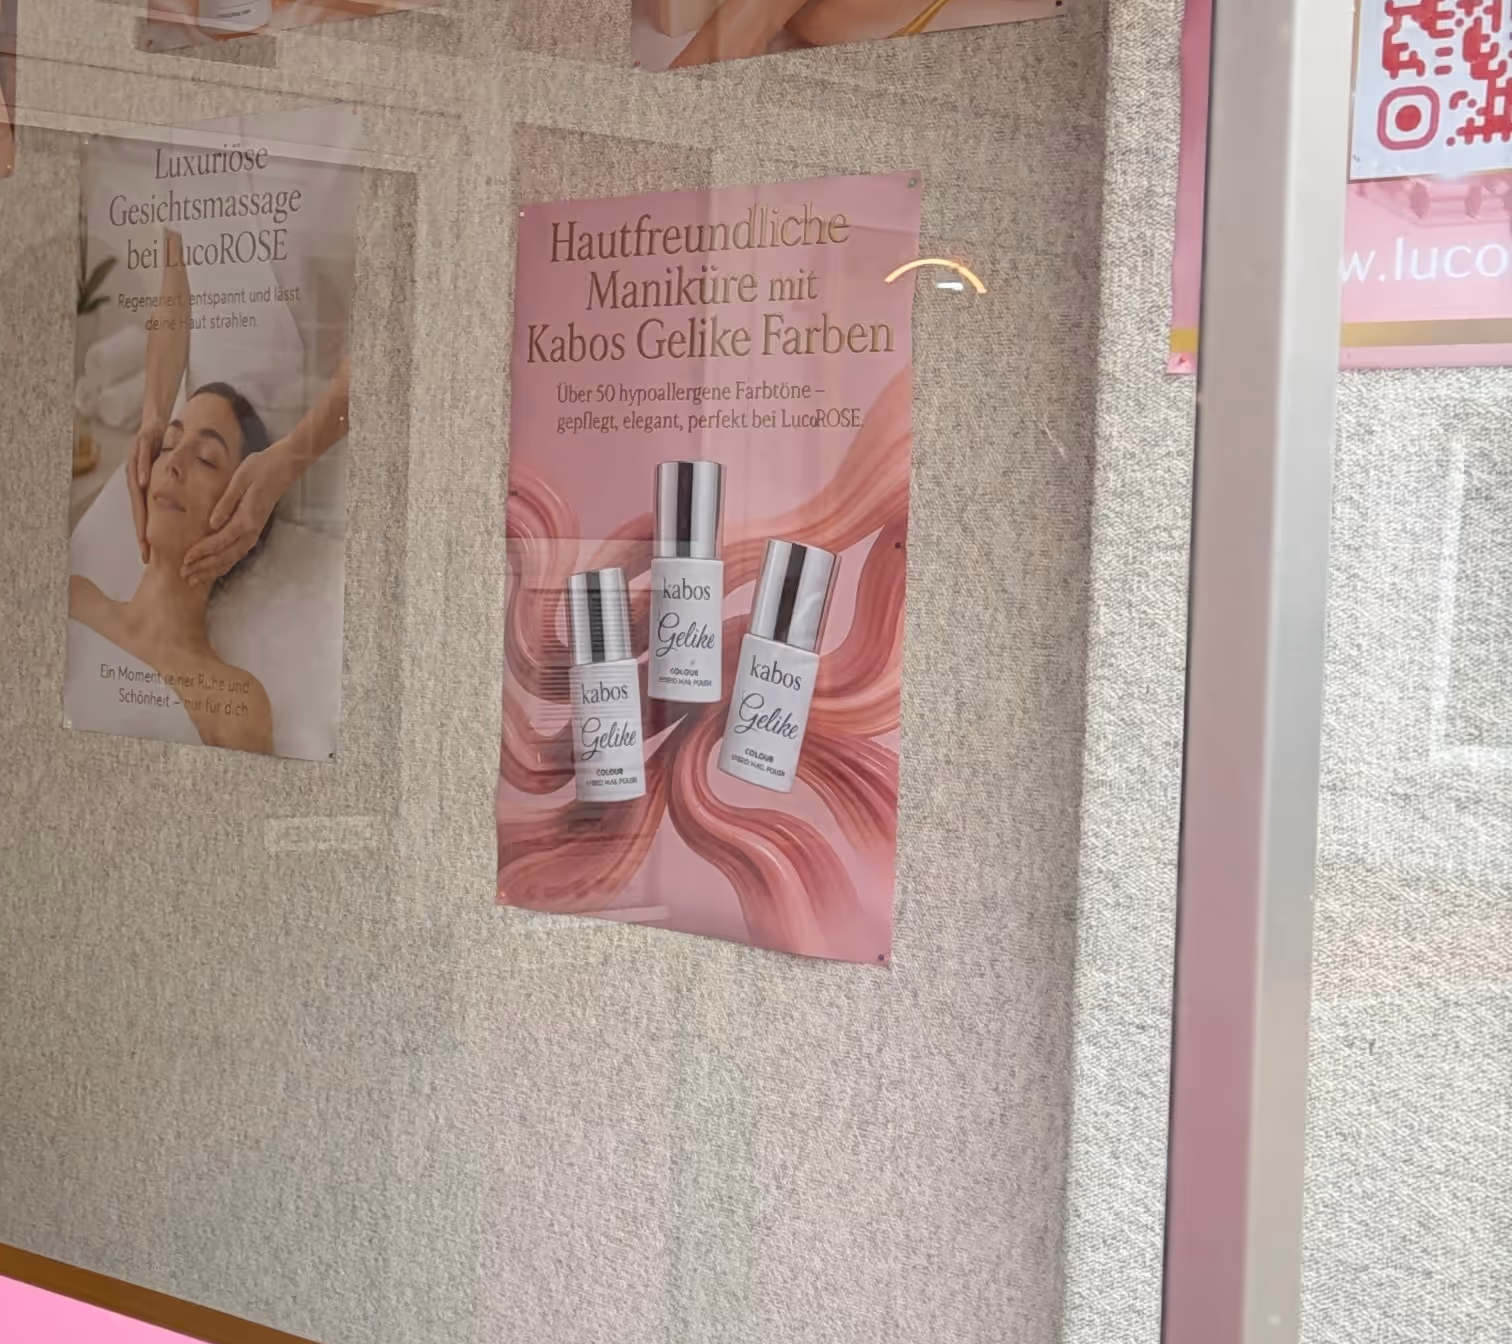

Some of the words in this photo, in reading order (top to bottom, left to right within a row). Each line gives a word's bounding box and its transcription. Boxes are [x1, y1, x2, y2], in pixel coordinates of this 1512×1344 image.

[154, 143, 269, 180] Luxuriöse
[108, 189, 303, 227] Gesichtsmassage
[126, 239, 159, 271] bei
[165, 228, 289, 268] LucoROSE
[550, 203, 851, 263] Hautfreundliche
[190, 289, 246, 309] entspannt
[249, 286, 271, 305] und
[274, 285, 301, 303] lässt
[586, 265, 759, 311] Maniküre
[768, 268, 819, 303] mit
[527, 322, 626, 364] Kabos
[636, 315, 753, 361] Gelike
[762, 312, 895, 357] Farben
[556, 381, 592, 404] Über
[595, 383, 616, 403] 50
[619, 381, 732, 405] hypoallergene
[735, 380, 812, 402] Farbtöne
[556, 409, 620, 435] gepflegt,
[623, 412, 684, 433] elegant,
[687, 407, 749, 434] perfekt
[752, 408, 777, 430] bei
[662, 578, 711, 601] kabos
[655, 612, 715, 657] Gelike
[100, 663, 116, 679] Ein
[118, 665, 162, 685] Moment
[749, 655, 802, 692] kabos
[118, 687, 171, 708] Schönheit
[580, 680, 629, 705] kabos
[734, 692, 799, 741] Gelike
[580, 717, 637, 761] Gelike
